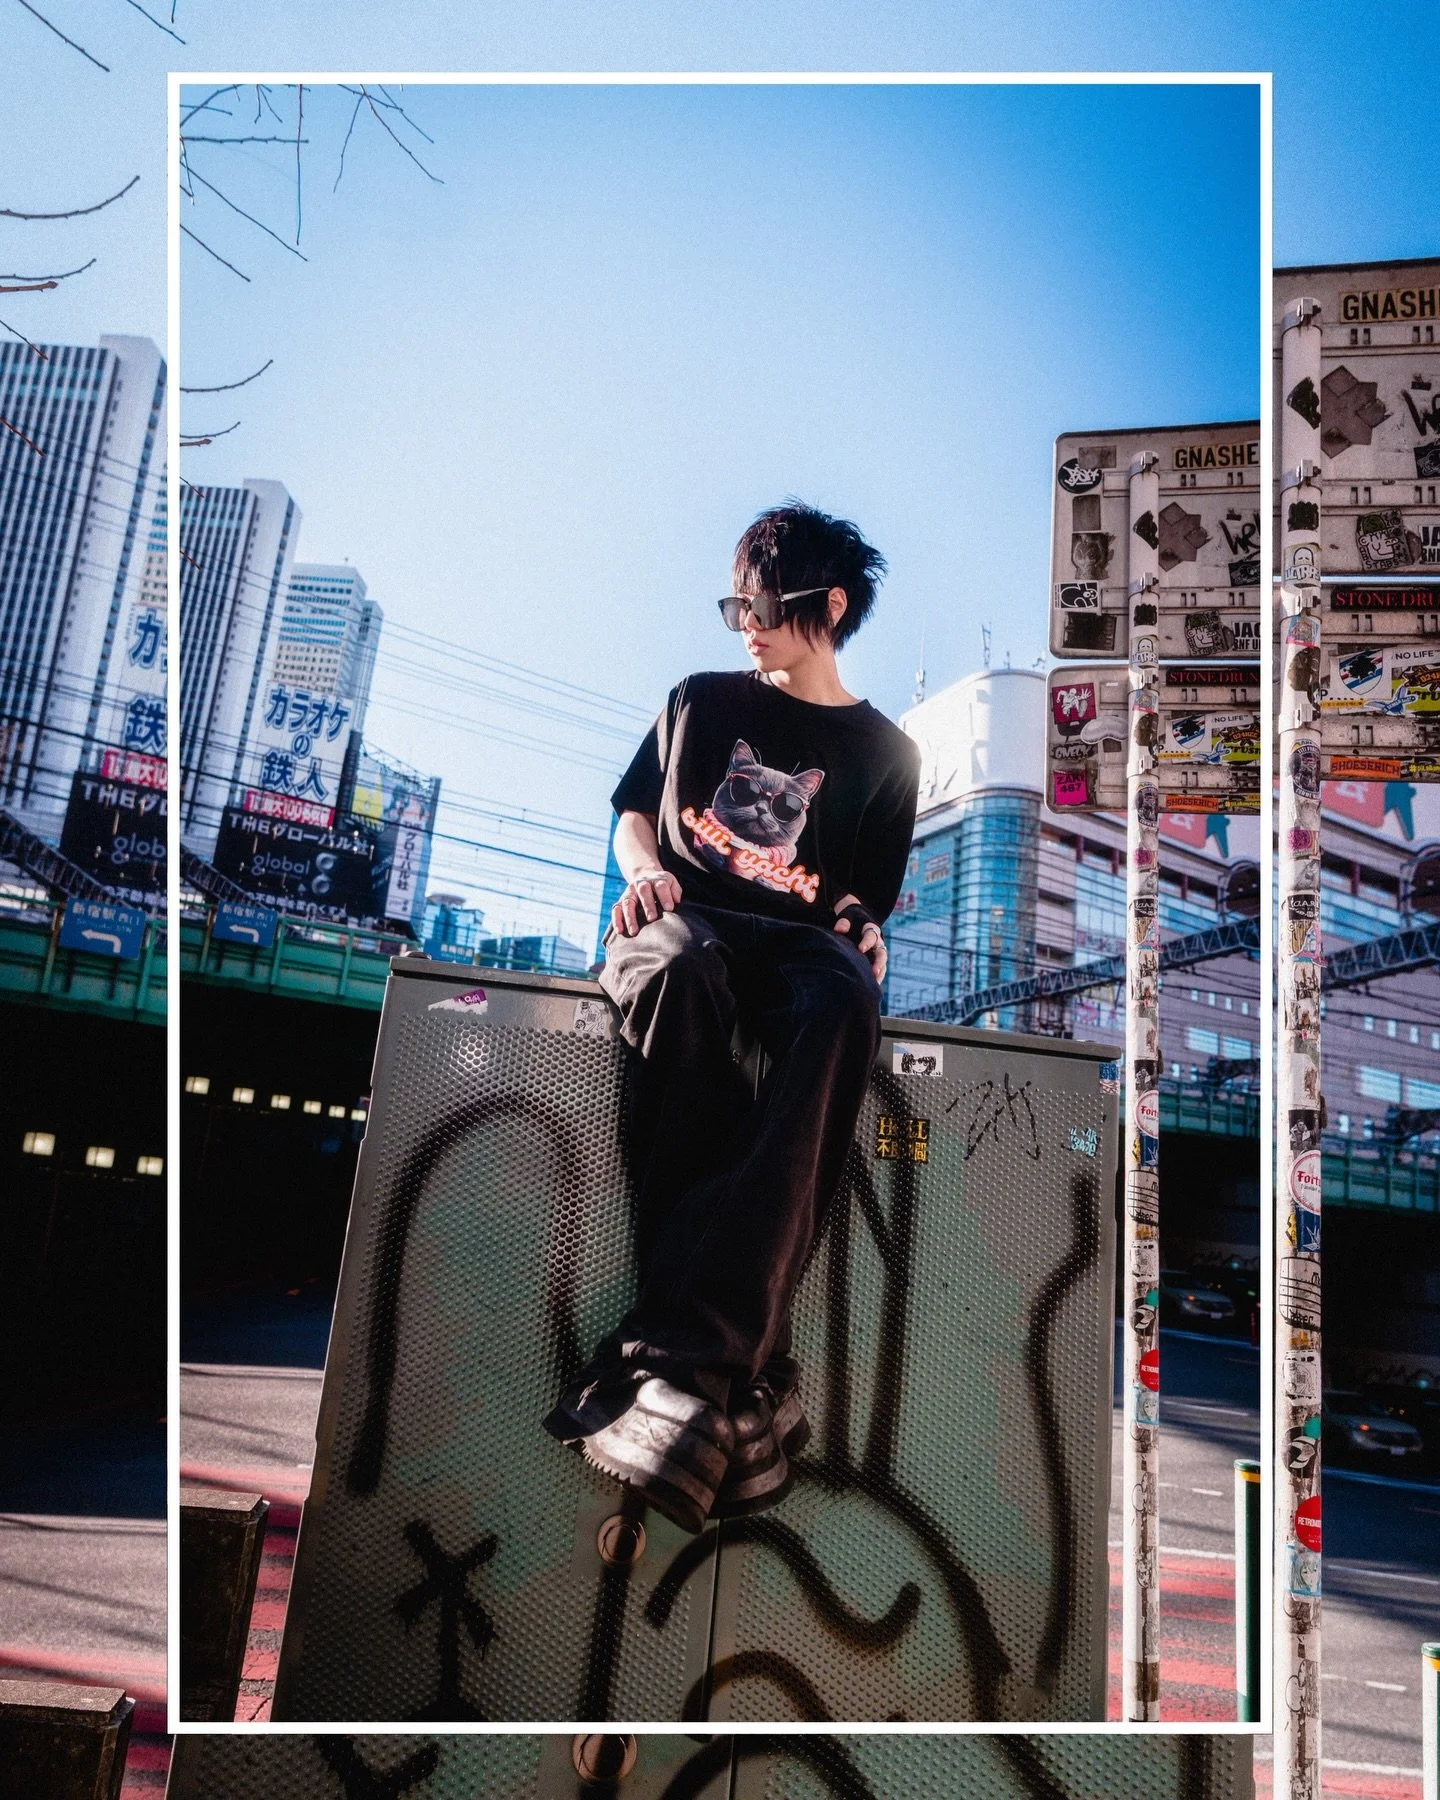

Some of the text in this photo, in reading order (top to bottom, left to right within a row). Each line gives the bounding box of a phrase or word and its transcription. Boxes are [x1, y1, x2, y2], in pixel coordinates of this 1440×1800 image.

[1343, 290, 1440, 320] GNASH
[1336, 591, 1398, 607] STONE
[1395, 652, 1411, 660] NO
[1169, 671, 1215, 682] STONE
[264, 684, 349, 743] カラオケ
[292, 730, 311, 759] の
[262, 750, 328, 801] 鉄人
[1331, 759, 1400, 775] SHOESERICH
[1061, 782, 1081, 792] 467
[229, 811, 370, 856] THEグローバル社
[251, 851, 311, 876] global
[733, 849, 820, 903] yacht
